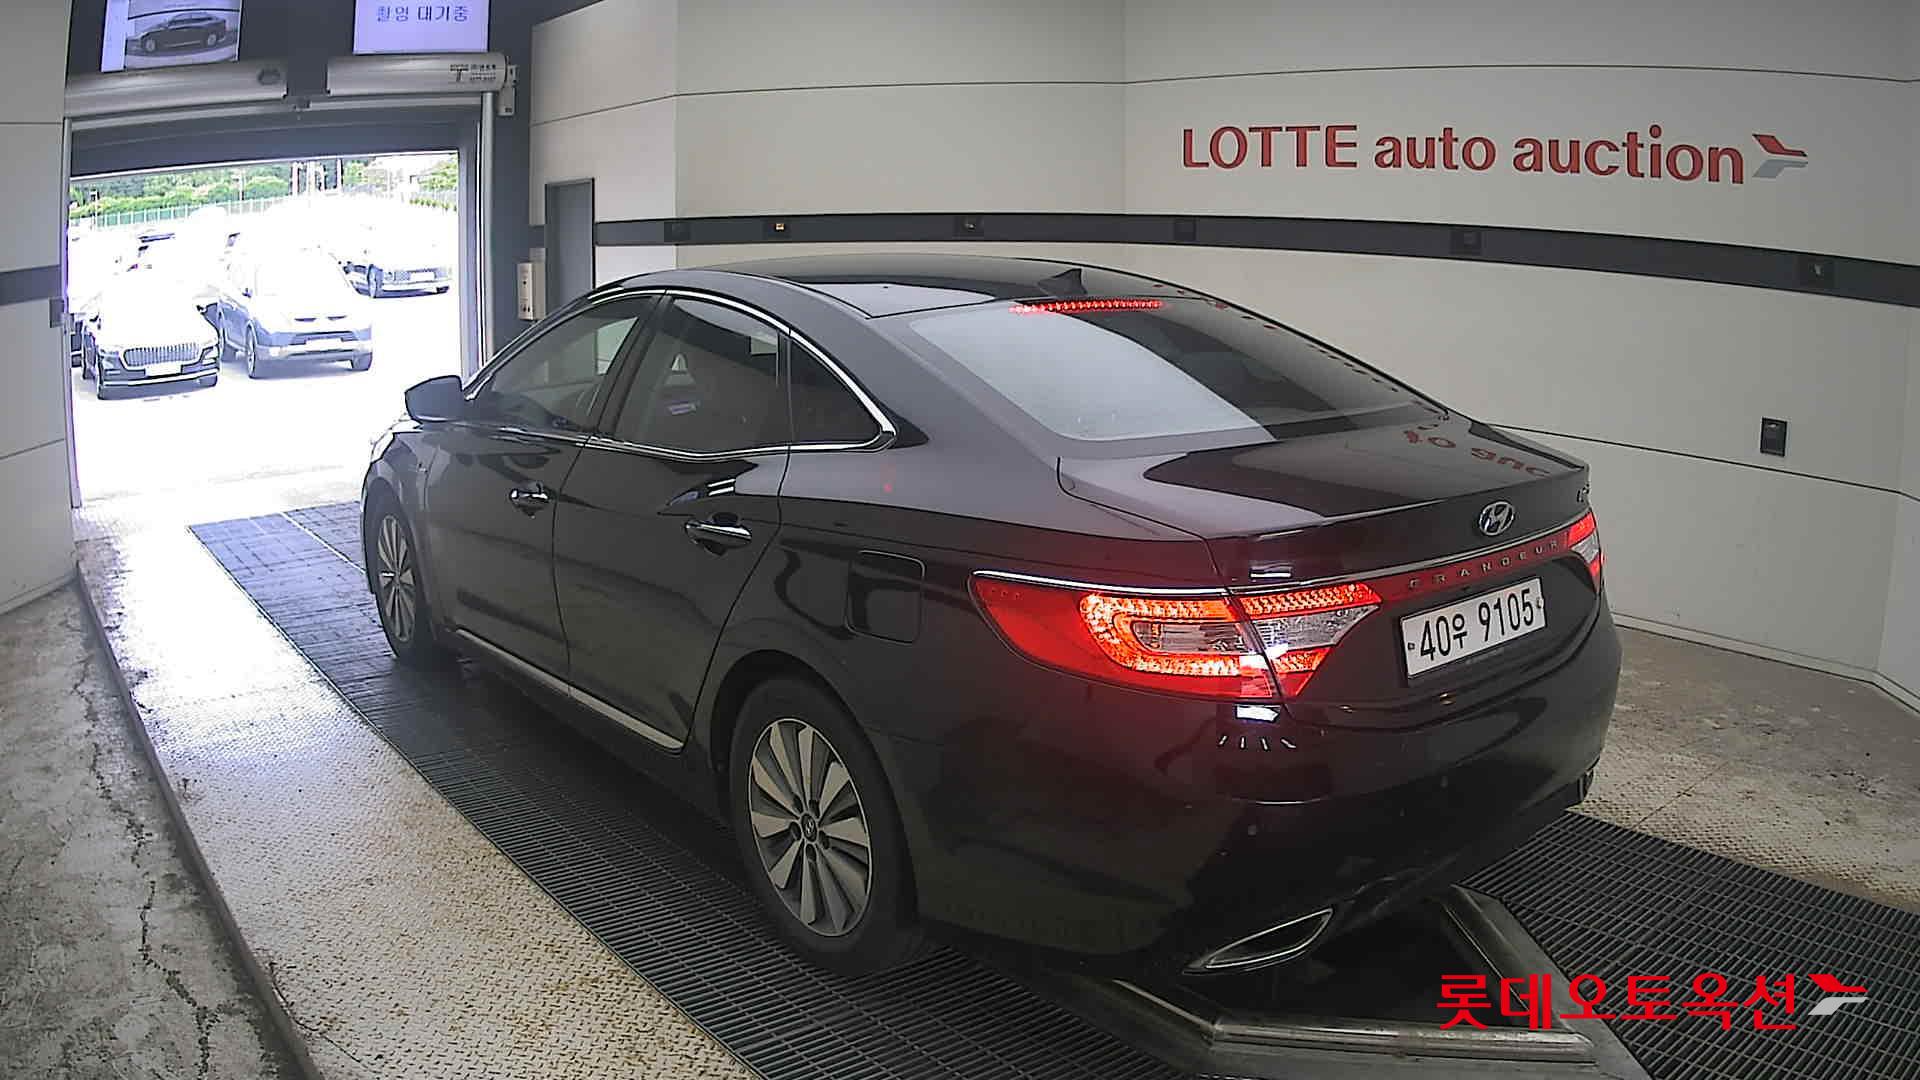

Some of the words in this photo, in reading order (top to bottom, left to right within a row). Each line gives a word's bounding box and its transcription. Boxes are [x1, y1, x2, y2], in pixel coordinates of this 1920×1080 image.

[417, 5, 468, 22] 대기중
[1183, 125, 1358, 169] LOTTE
[1374, 127, 1497, 171] auto
[1513, 124, 1744, 184] auction
[1409, 541, 1559, 588] GRANDEUR
[1420, 613, 1468, 661] 40우
[1478, 588, 1534, 642] 9105
